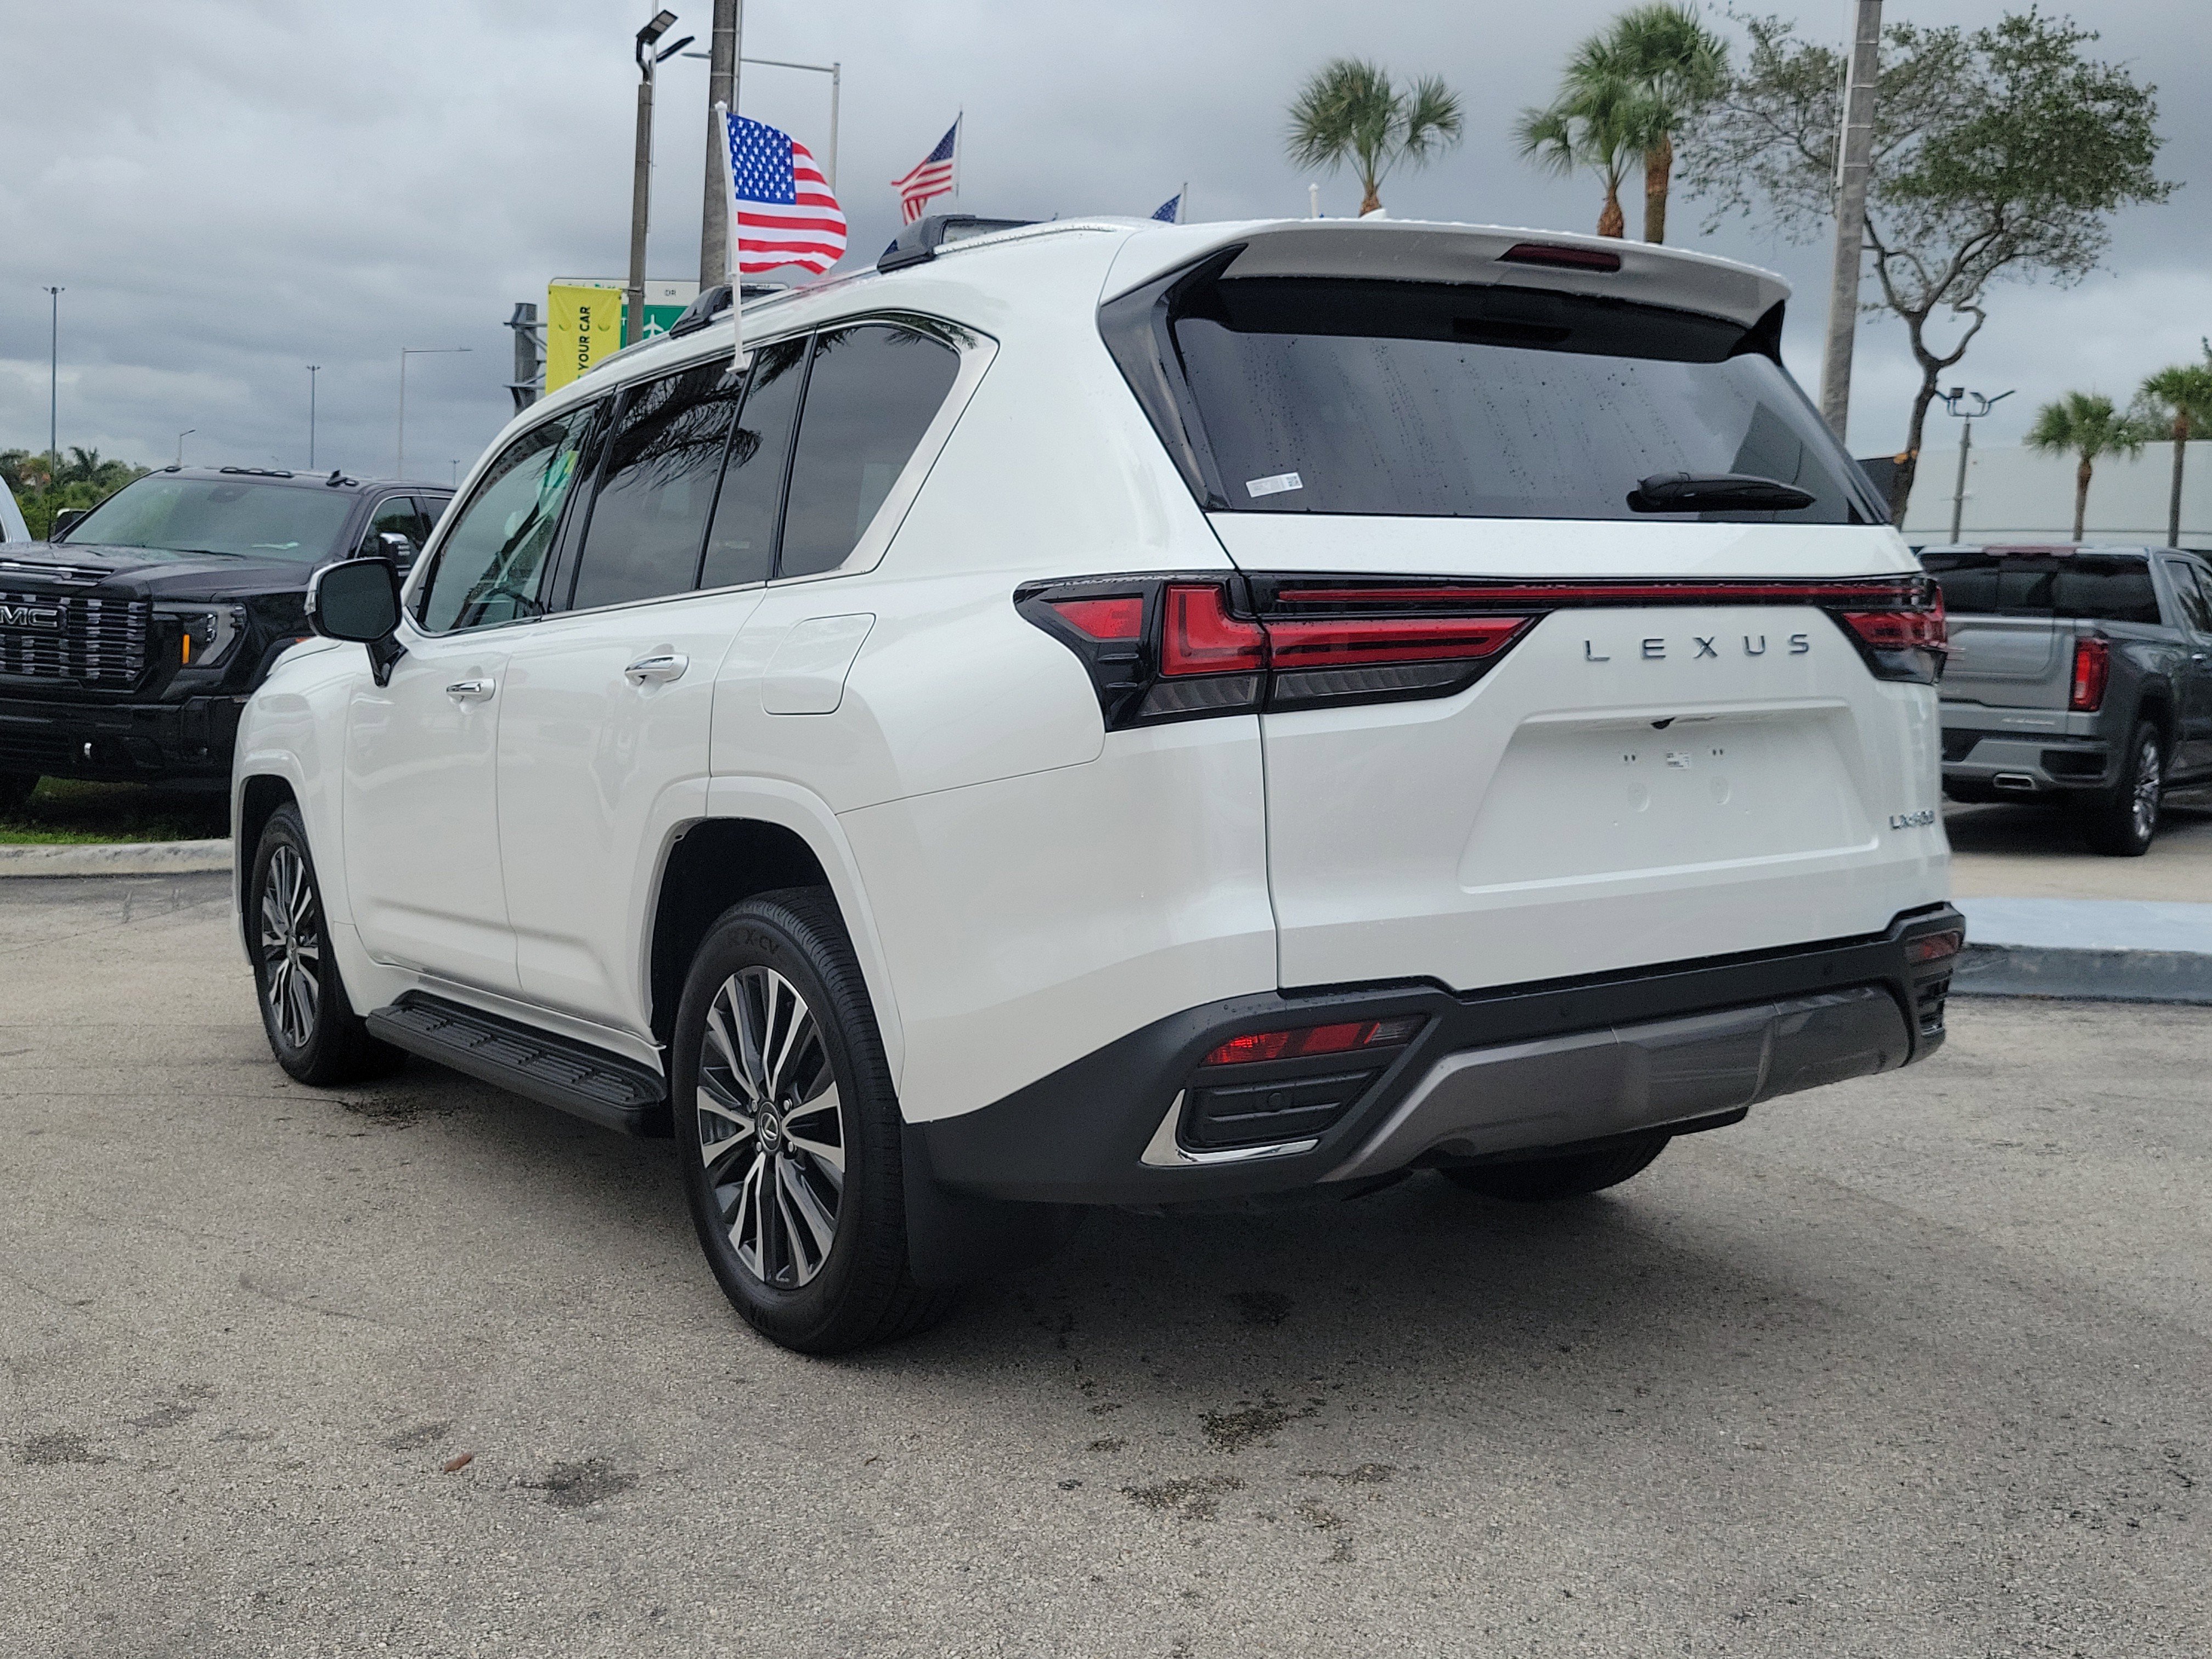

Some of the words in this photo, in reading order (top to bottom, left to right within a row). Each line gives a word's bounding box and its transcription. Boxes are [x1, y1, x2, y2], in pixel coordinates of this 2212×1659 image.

[579, 306, 591, 332] CAR
[578, 335, 591, 371] YOUR
[0, 605, 58, 628] MC
[1584, 634, 1809, 662] LEXUS
